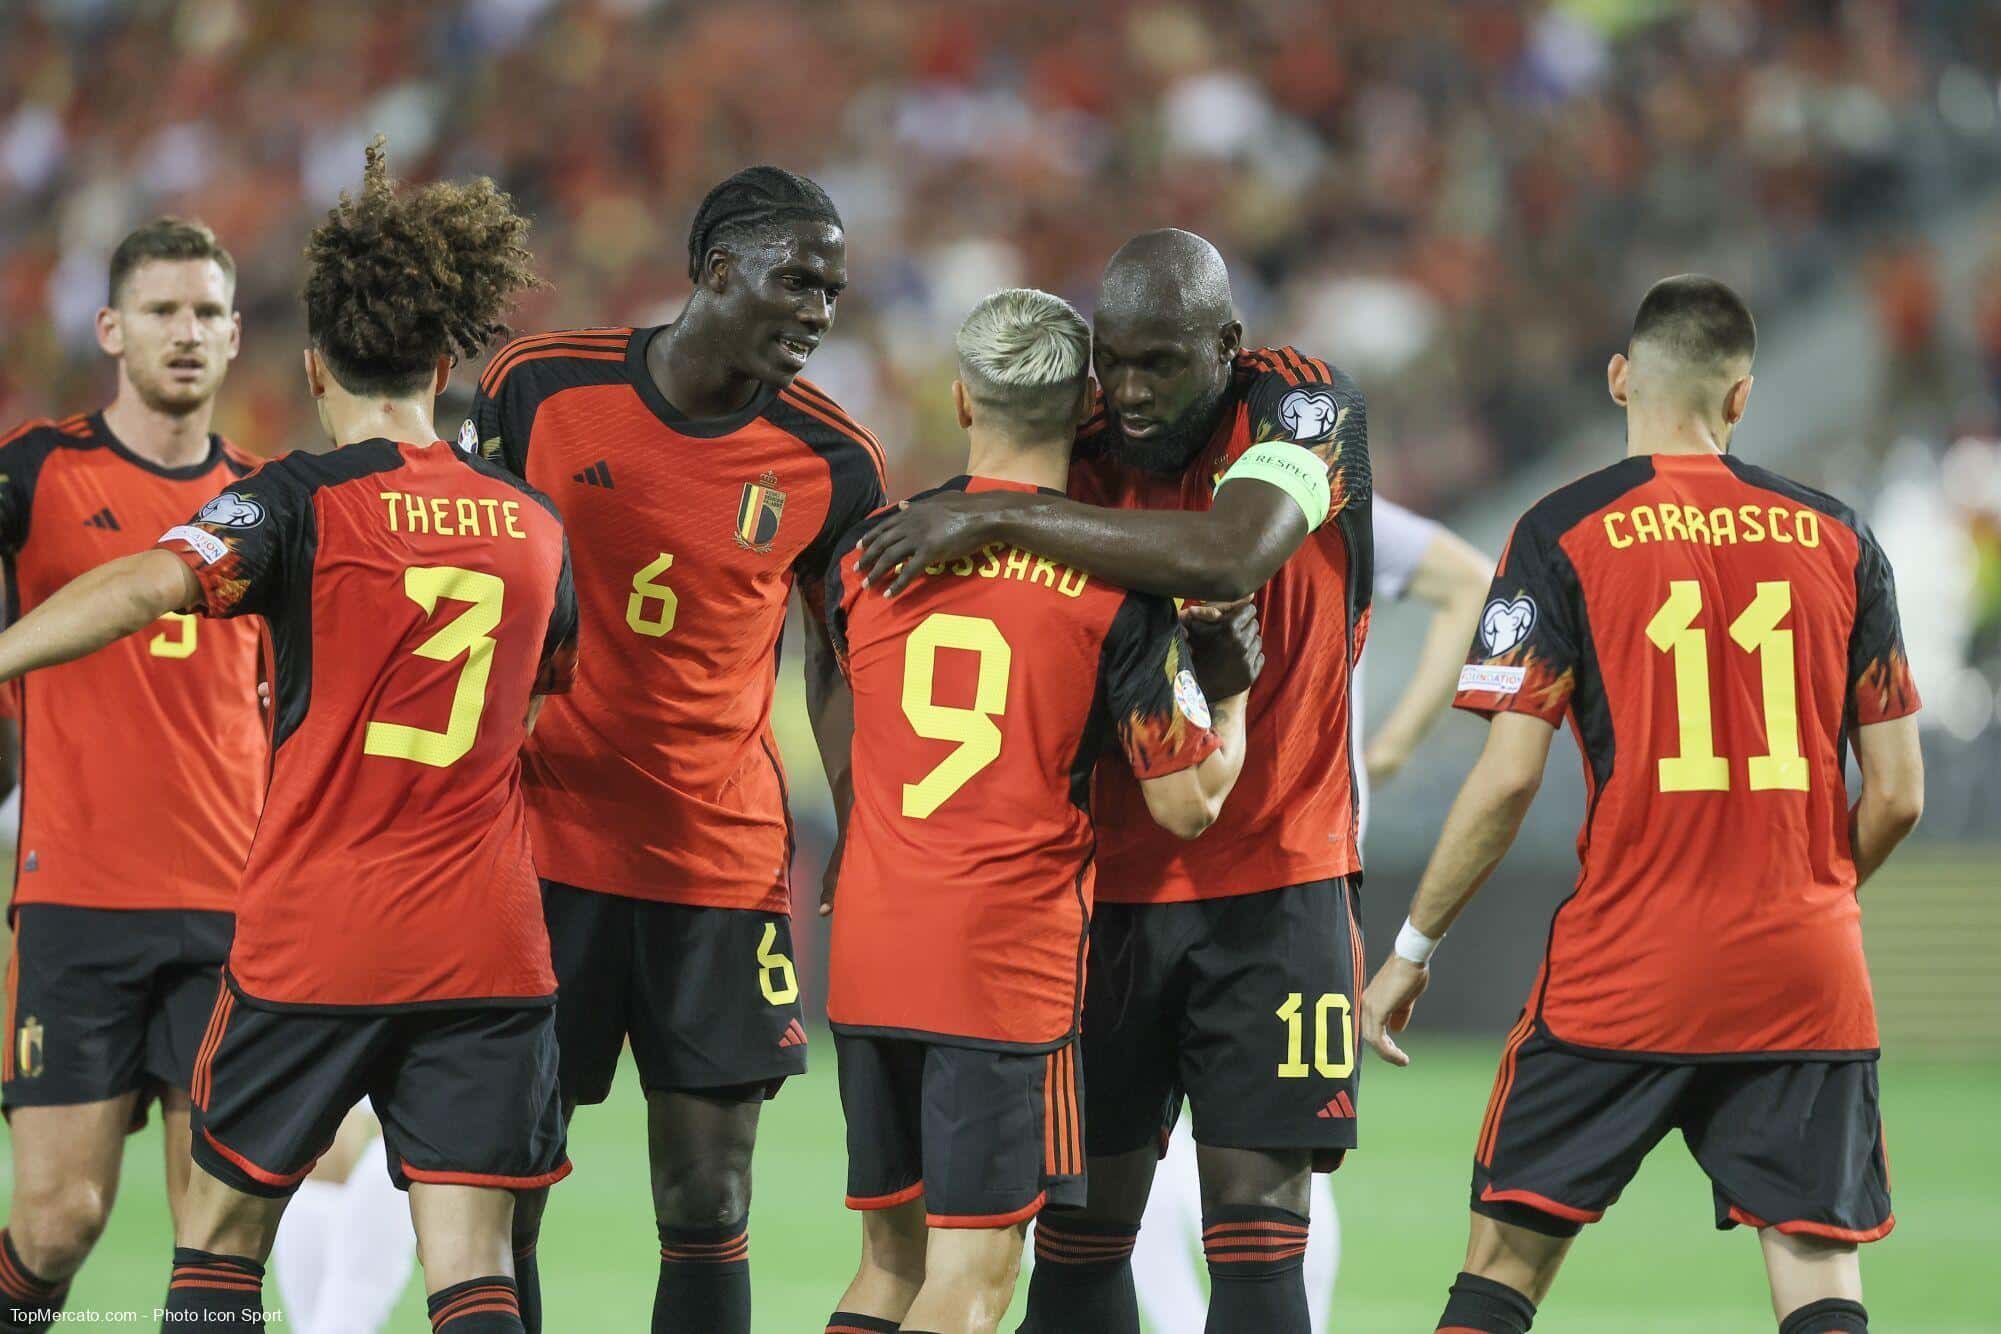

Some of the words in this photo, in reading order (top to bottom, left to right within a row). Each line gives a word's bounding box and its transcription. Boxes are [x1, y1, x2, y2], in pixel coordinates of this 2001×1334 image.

[379, 491, 527, 539] THEATE
[1256, 455, 1318, 491] RESPECT
[1602, 502, 1820, 549] CARRASCO
[625, 552, 679, 638] 6
[895, 541, 1089, 598] SSARD
[364, 565, 505, 768] 3
[1645, 580, 1811, 793] 11
[900, 613, 1013, 820] 9
[756, 922, 799, 1006] 6
[1275, 992, 1355, 1079] 10
